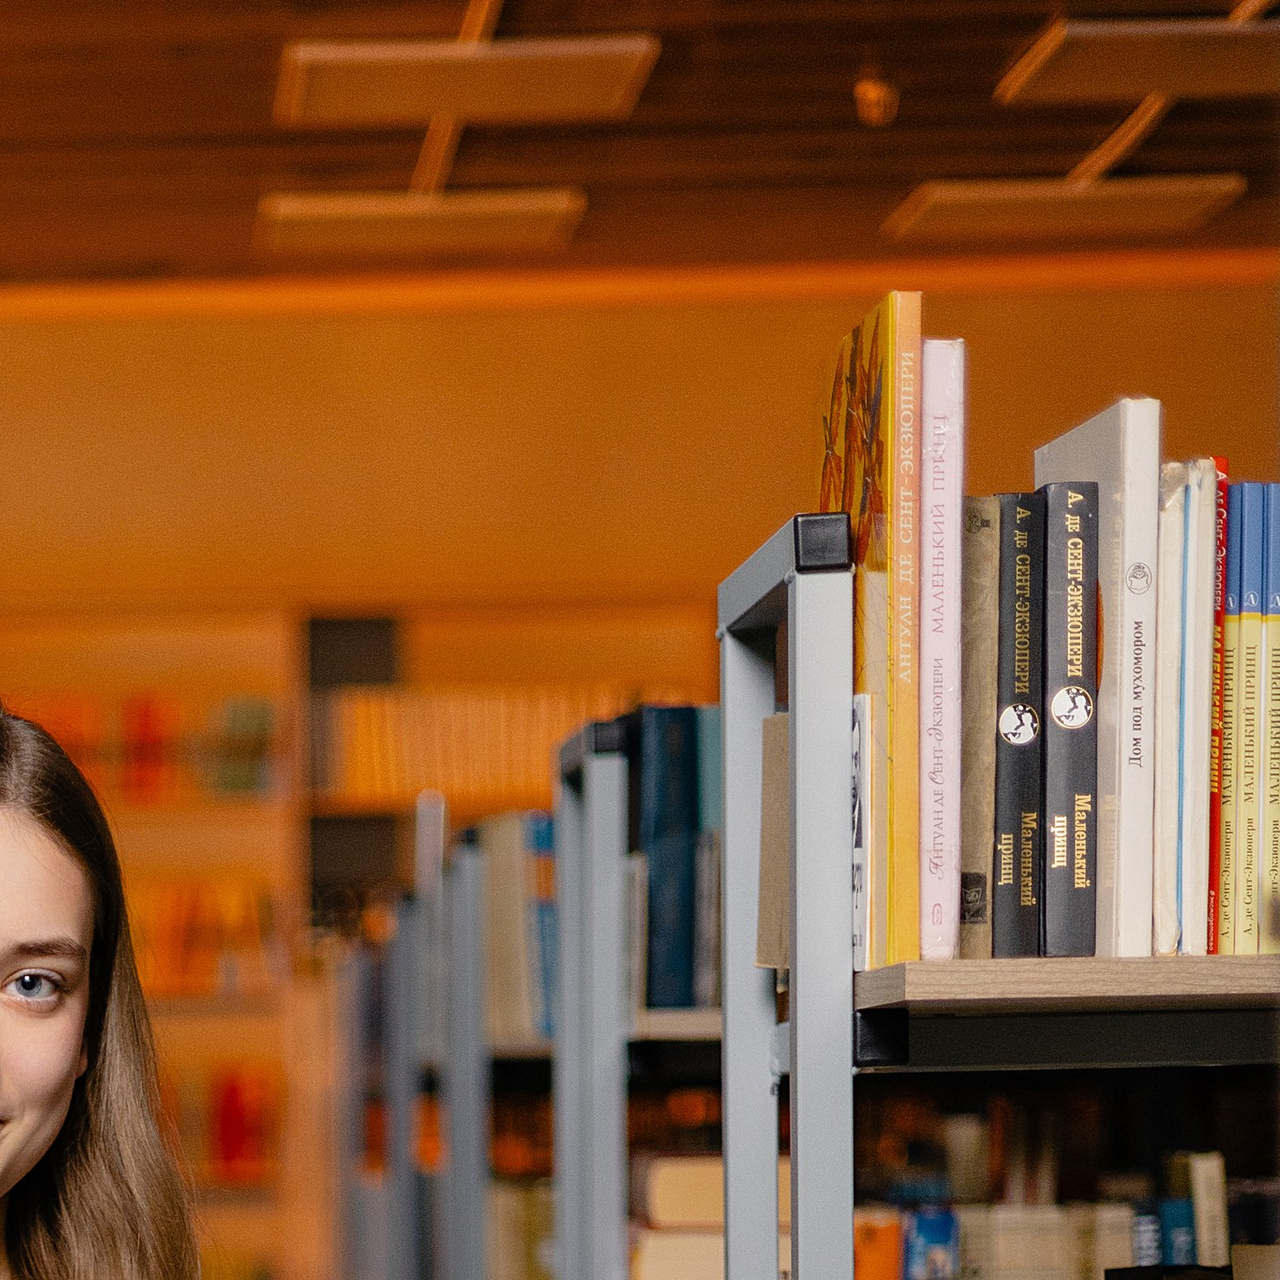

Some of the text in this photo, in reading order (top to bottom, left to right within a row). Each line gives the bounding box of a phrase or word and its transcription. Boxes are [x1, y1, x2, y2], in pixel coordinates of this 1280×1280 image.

[898, 351, 915, 684] АНТУАН ДЕ СЕНТ-ЭКЗЮПЕРИ
[930, 415, 949, 634] МАЛЕНЬКИЙ ПРИНЦ
[1015, 506, 1031, 524] А.
[1067, 491, 1083, 509] А.
[1014, 554, 1031, 694] СЕНТ-ЭКЗЮПЕРИ
[1066, 537, 1084, 677] СЕНТ-ЭКЗЮПЕРИ
[1128, 620, 1146, 768] Дом под мухомором
[1221, 647, 1236, 806] МАЛЕНЬКИЙ ПРИНЦ
[1242, 644, 1257, 803] МАЛЕНЬКИЙ ПРИНЦ
[1268, 647, 1280, 806] МАЛЕНЬКИЙ ПРИНЦ
[998, 833, 1016, 885] принц
[1020, 812, 1037, 906] Маленький
[1051, 816, 1069, 868] принц
[1074, 794, 1091, 888] Маленький
[1221, 820, 1233, 908] Сент-Экзюпери
[1242, 817, 1255, 936] А. де Сент-Экзюпери
[1222, 910, 1231, 923] де
